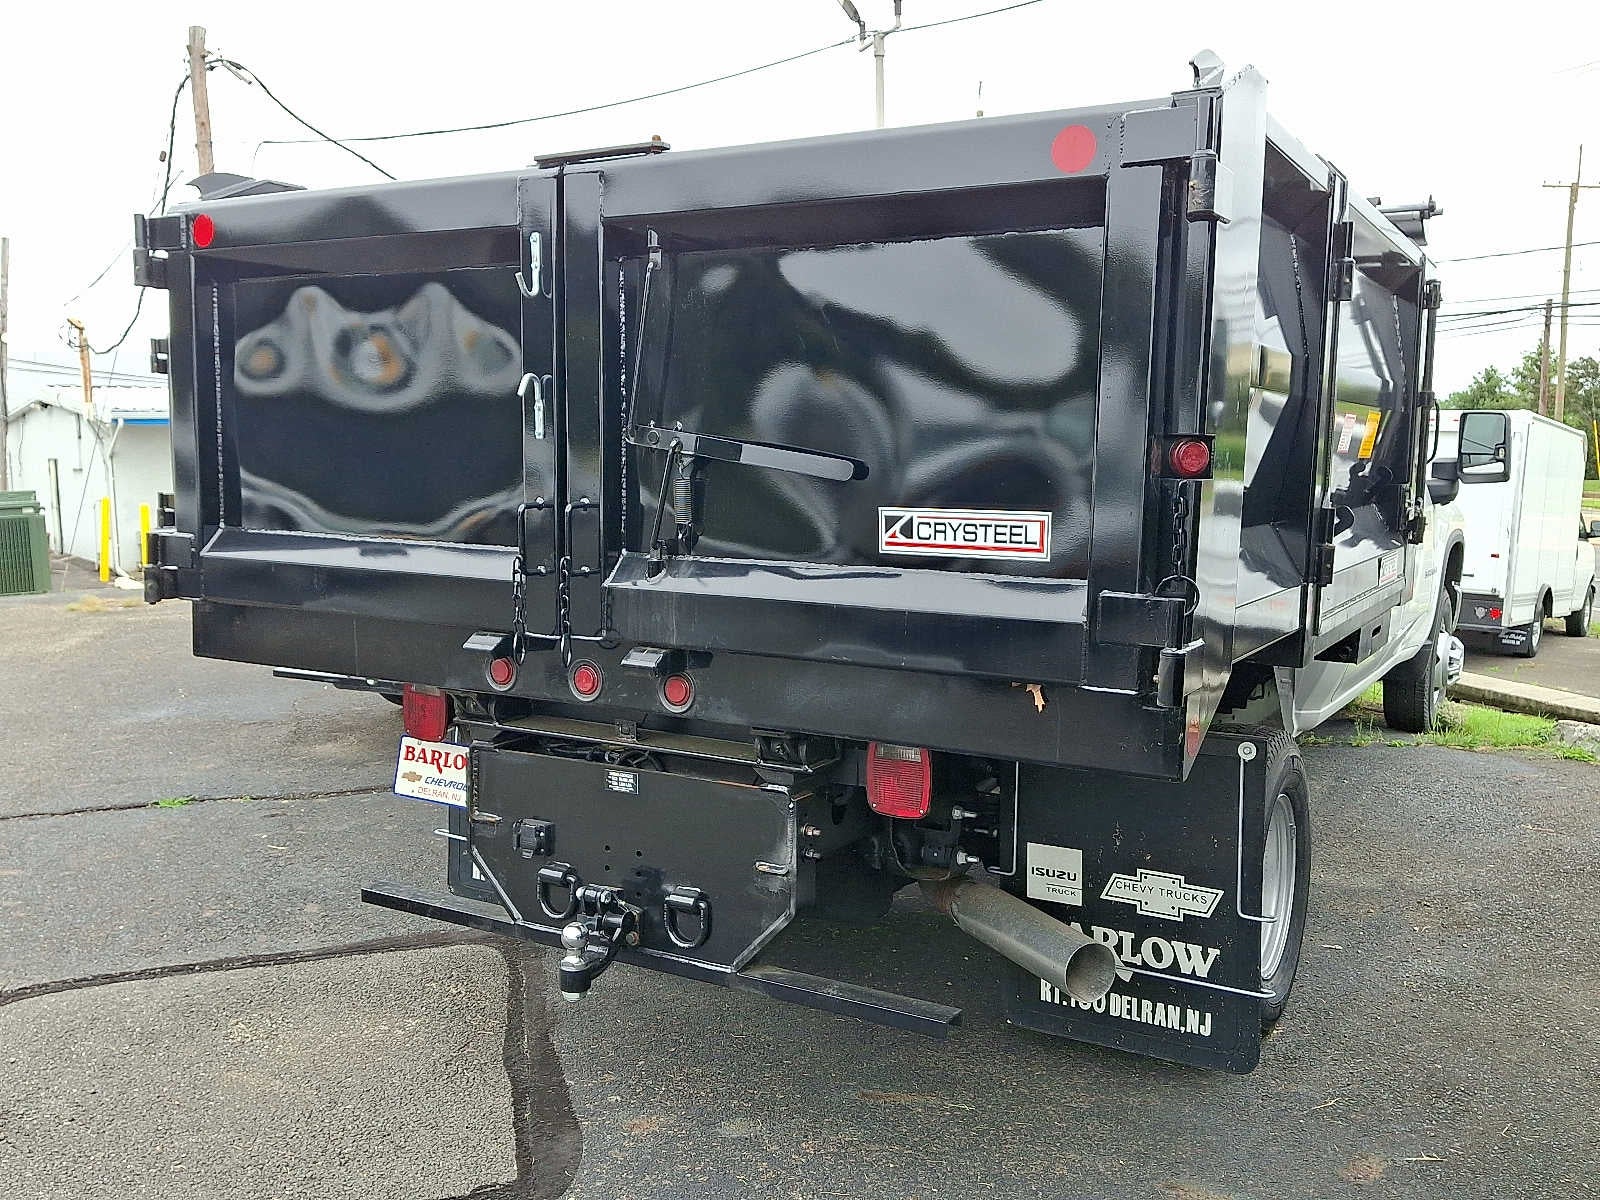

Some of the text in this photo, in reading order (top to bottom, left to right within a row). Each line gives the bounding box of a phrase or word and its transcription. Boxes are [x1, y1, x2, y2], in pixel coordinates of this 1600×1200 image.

[916, 521, 1038, 546] CRYSTEEL
[1031, 866, 1077, 882] ISUZU
[1046, 886, 1077, 897] TRUCK
[1114, 880, 1208, 906] CHEVY TRUCKS
[1070, 922, 1221, 983] RLOW
